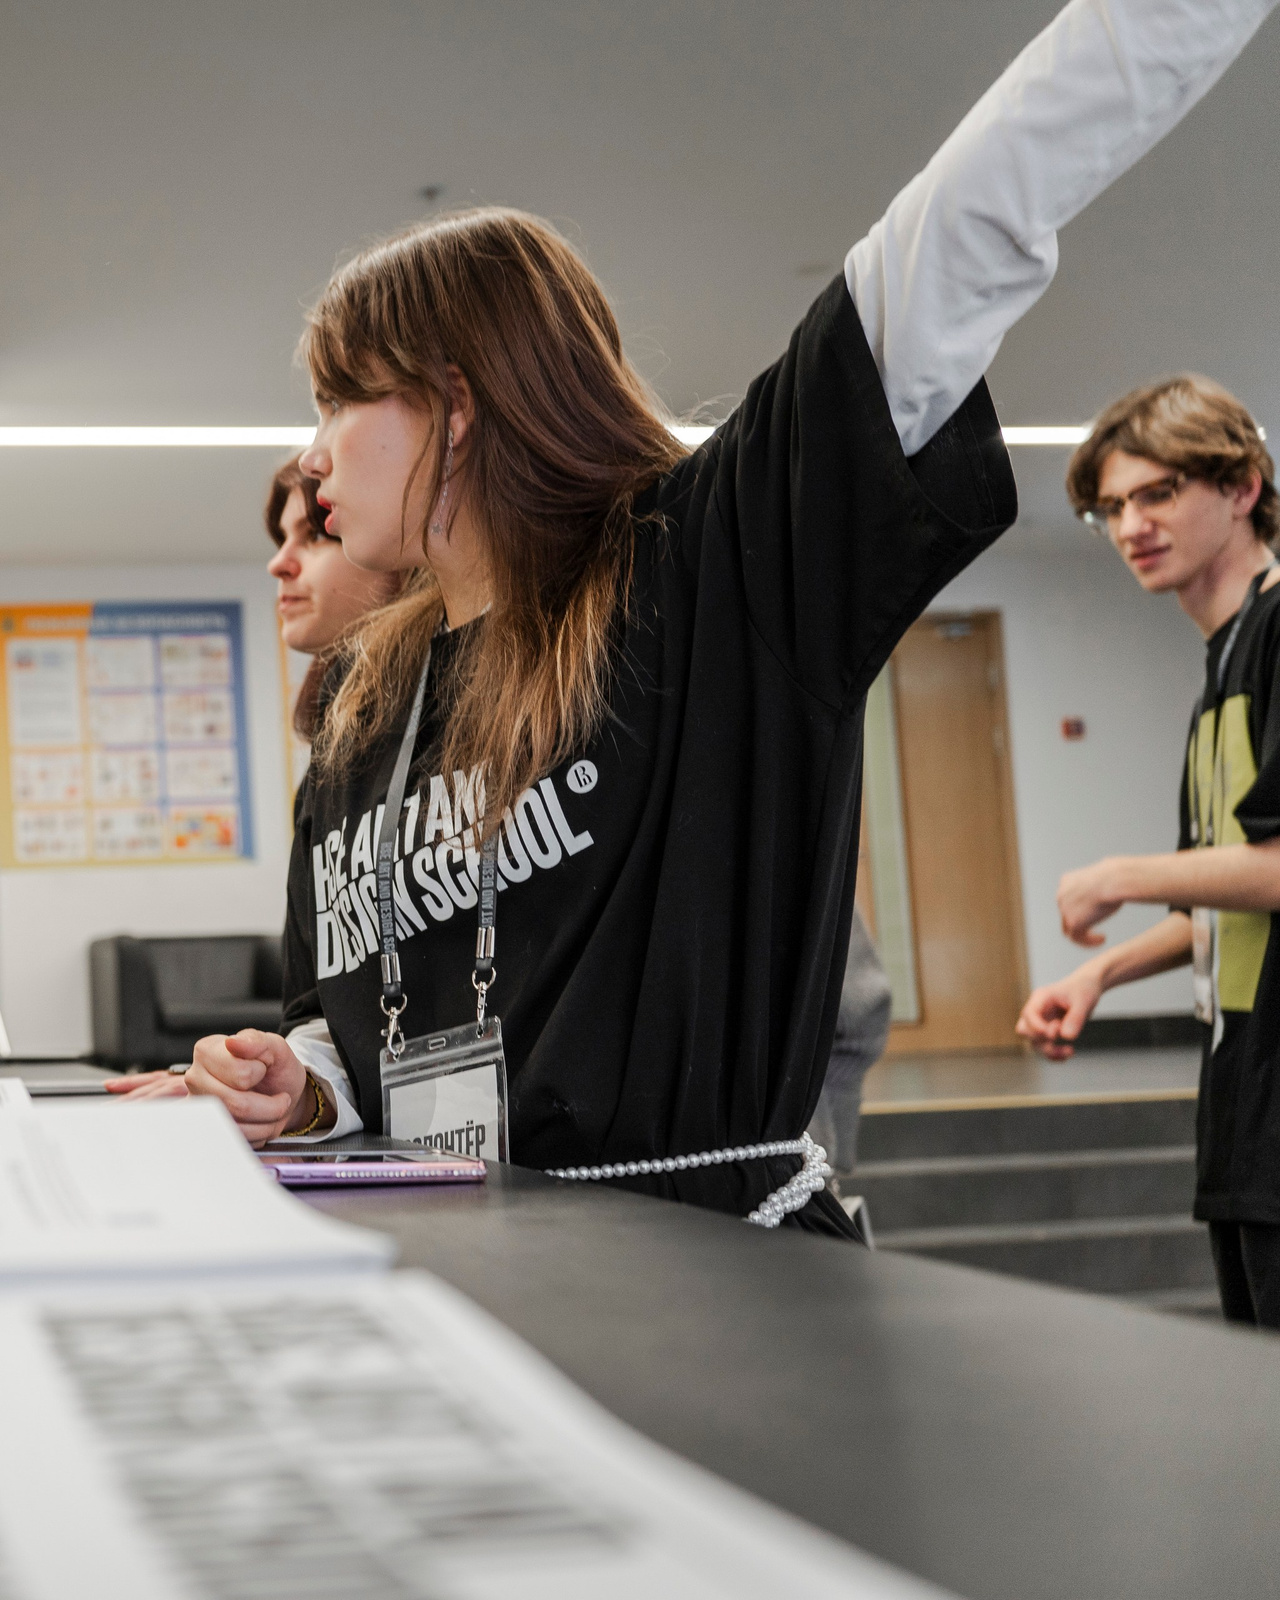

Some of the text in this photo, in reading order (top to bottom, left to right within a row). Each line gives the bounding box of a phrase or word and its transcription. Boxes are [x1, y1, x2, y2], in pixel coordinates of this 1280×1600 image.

[313, 816, 348, 912] HSE
[424, 760, 493, 845] AN
[378, 880, 391, 899] AND
[380, 900, 394, 936] DESIGN
